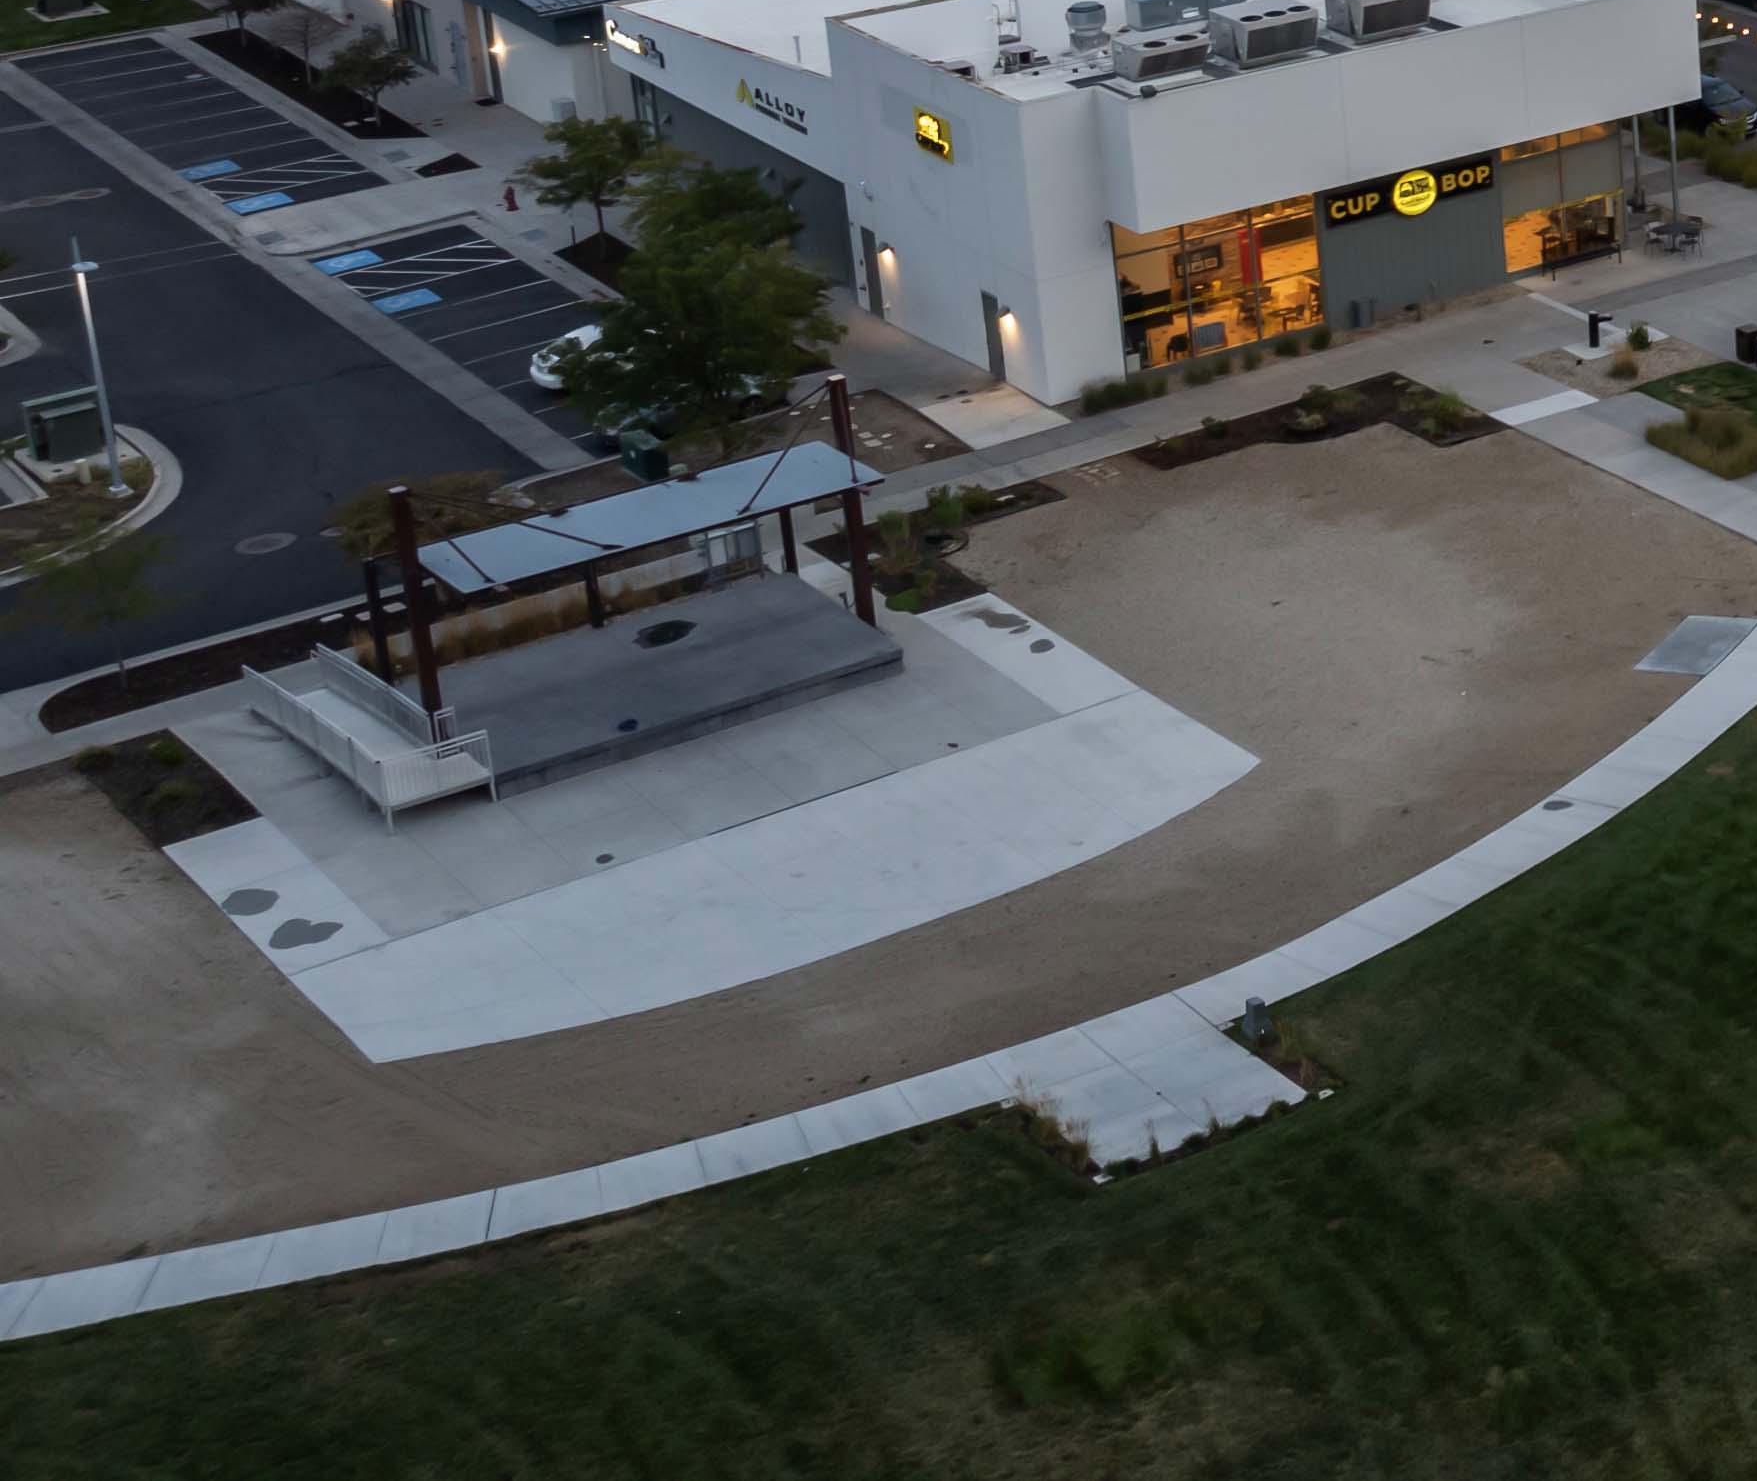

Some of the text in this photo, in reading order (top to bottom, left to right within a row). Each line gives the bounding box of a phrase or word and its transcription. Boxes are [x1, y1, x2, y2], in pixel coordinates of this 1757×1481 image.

[755, 87, 807, 123] ALLOY
[1330, 192, 1380, 219] CUP
[1441, 165, 1490, 192] BOP
